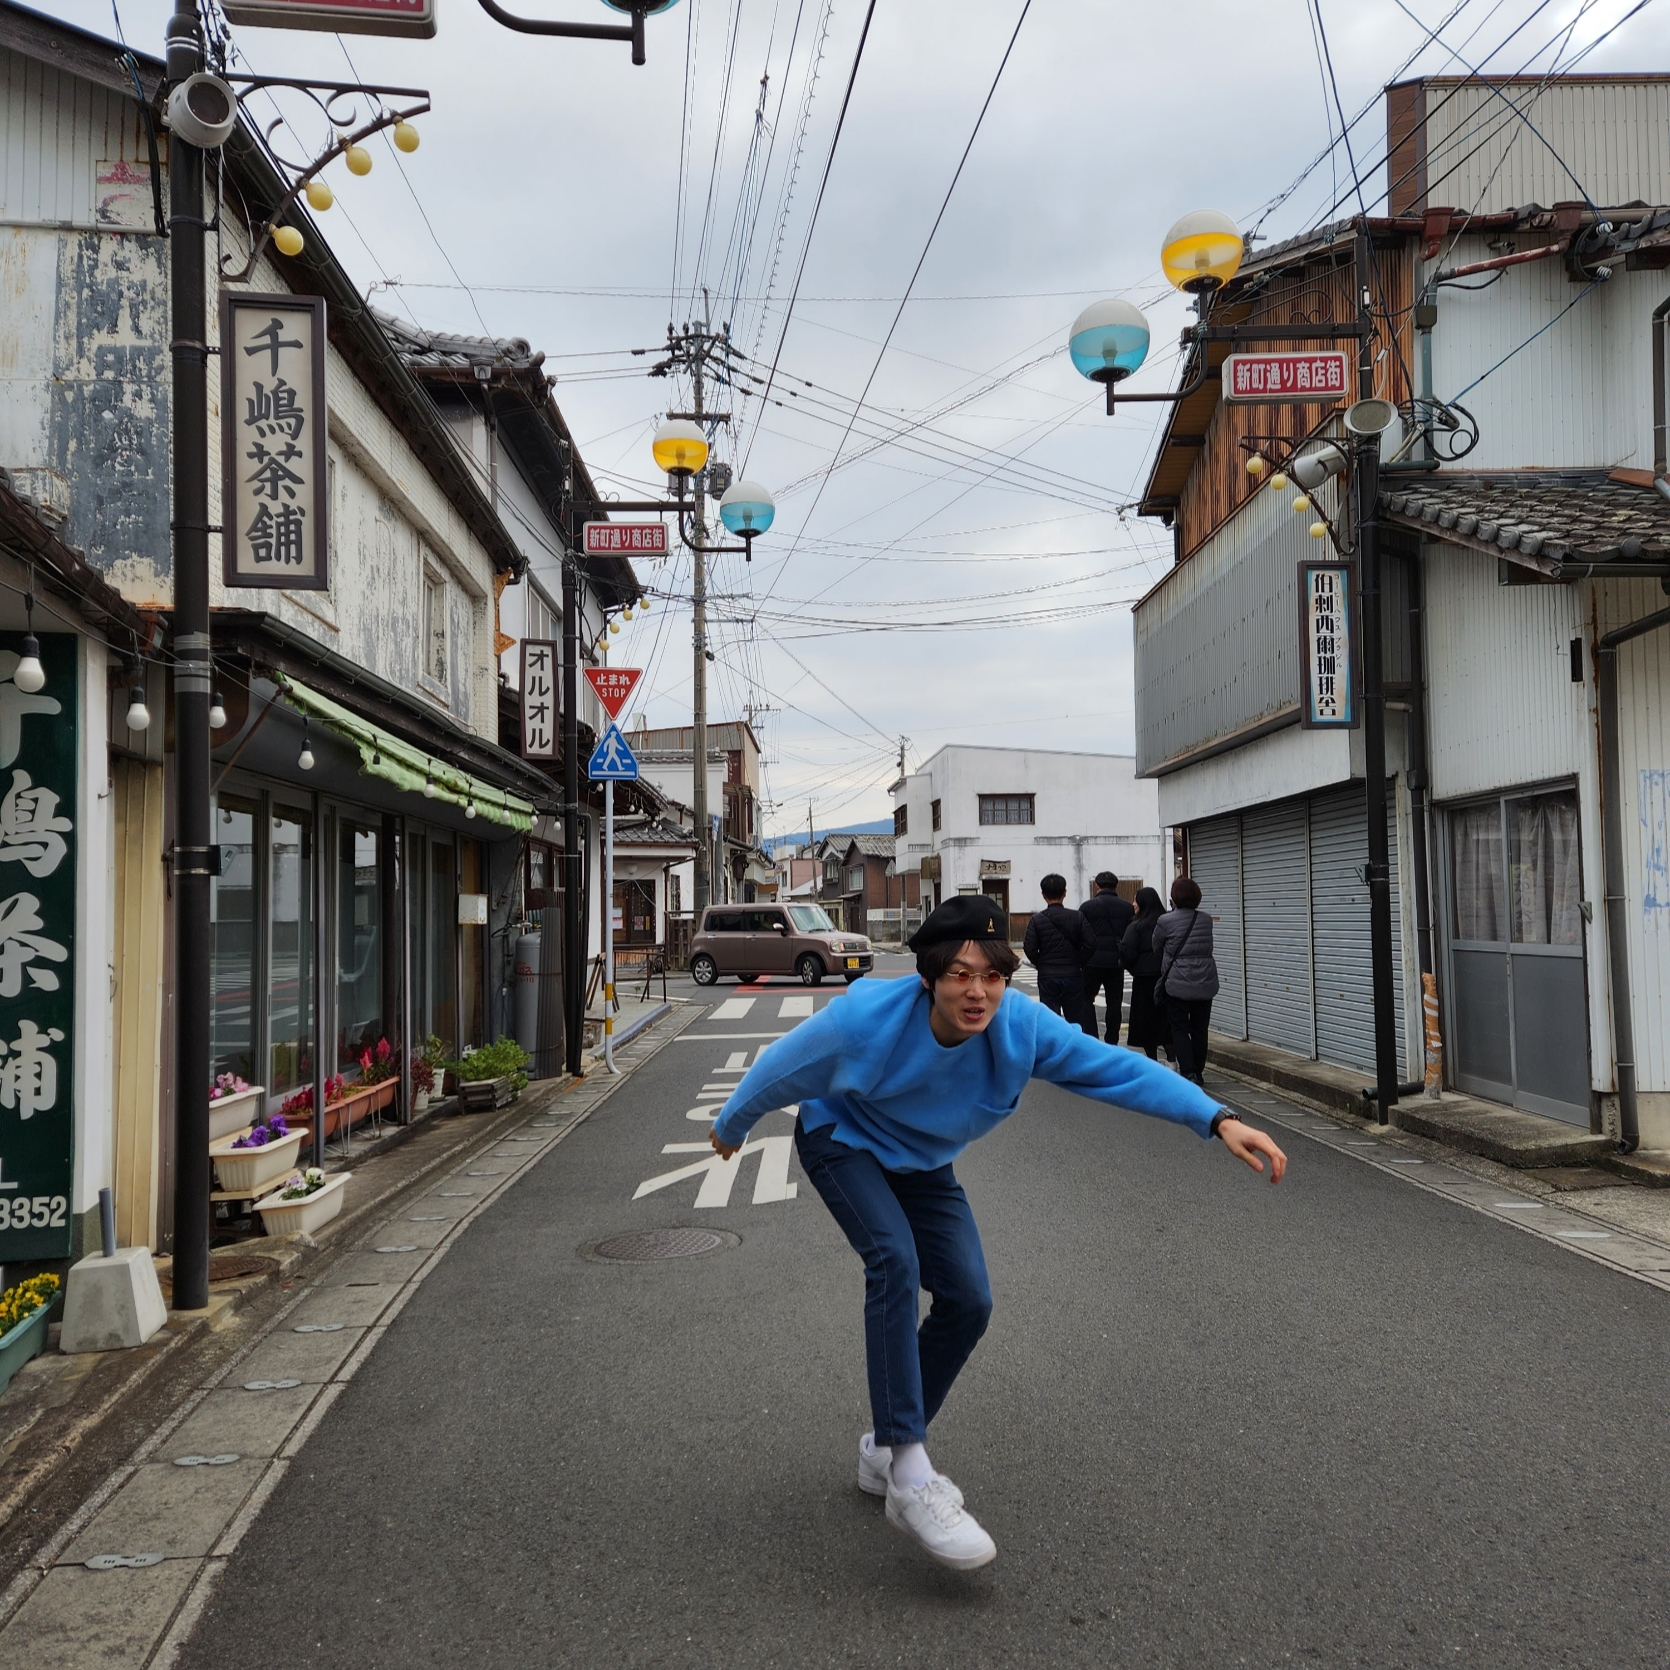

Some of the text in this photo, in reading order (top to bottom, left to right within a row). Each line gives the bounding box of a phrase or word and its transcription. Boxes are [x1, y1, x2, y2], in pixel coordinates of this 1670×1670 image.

[1236, 359, 1341, 391] 新町通り商店街
[243, 317, 306, 565] 千嶋茶舗
[589, 527, 663, 548] 新町通り商店街
[595, 673, 631, 686] 止まれ
[602, 687, 626, 698] STOP
[528, 649, 551, 749] オルオル
